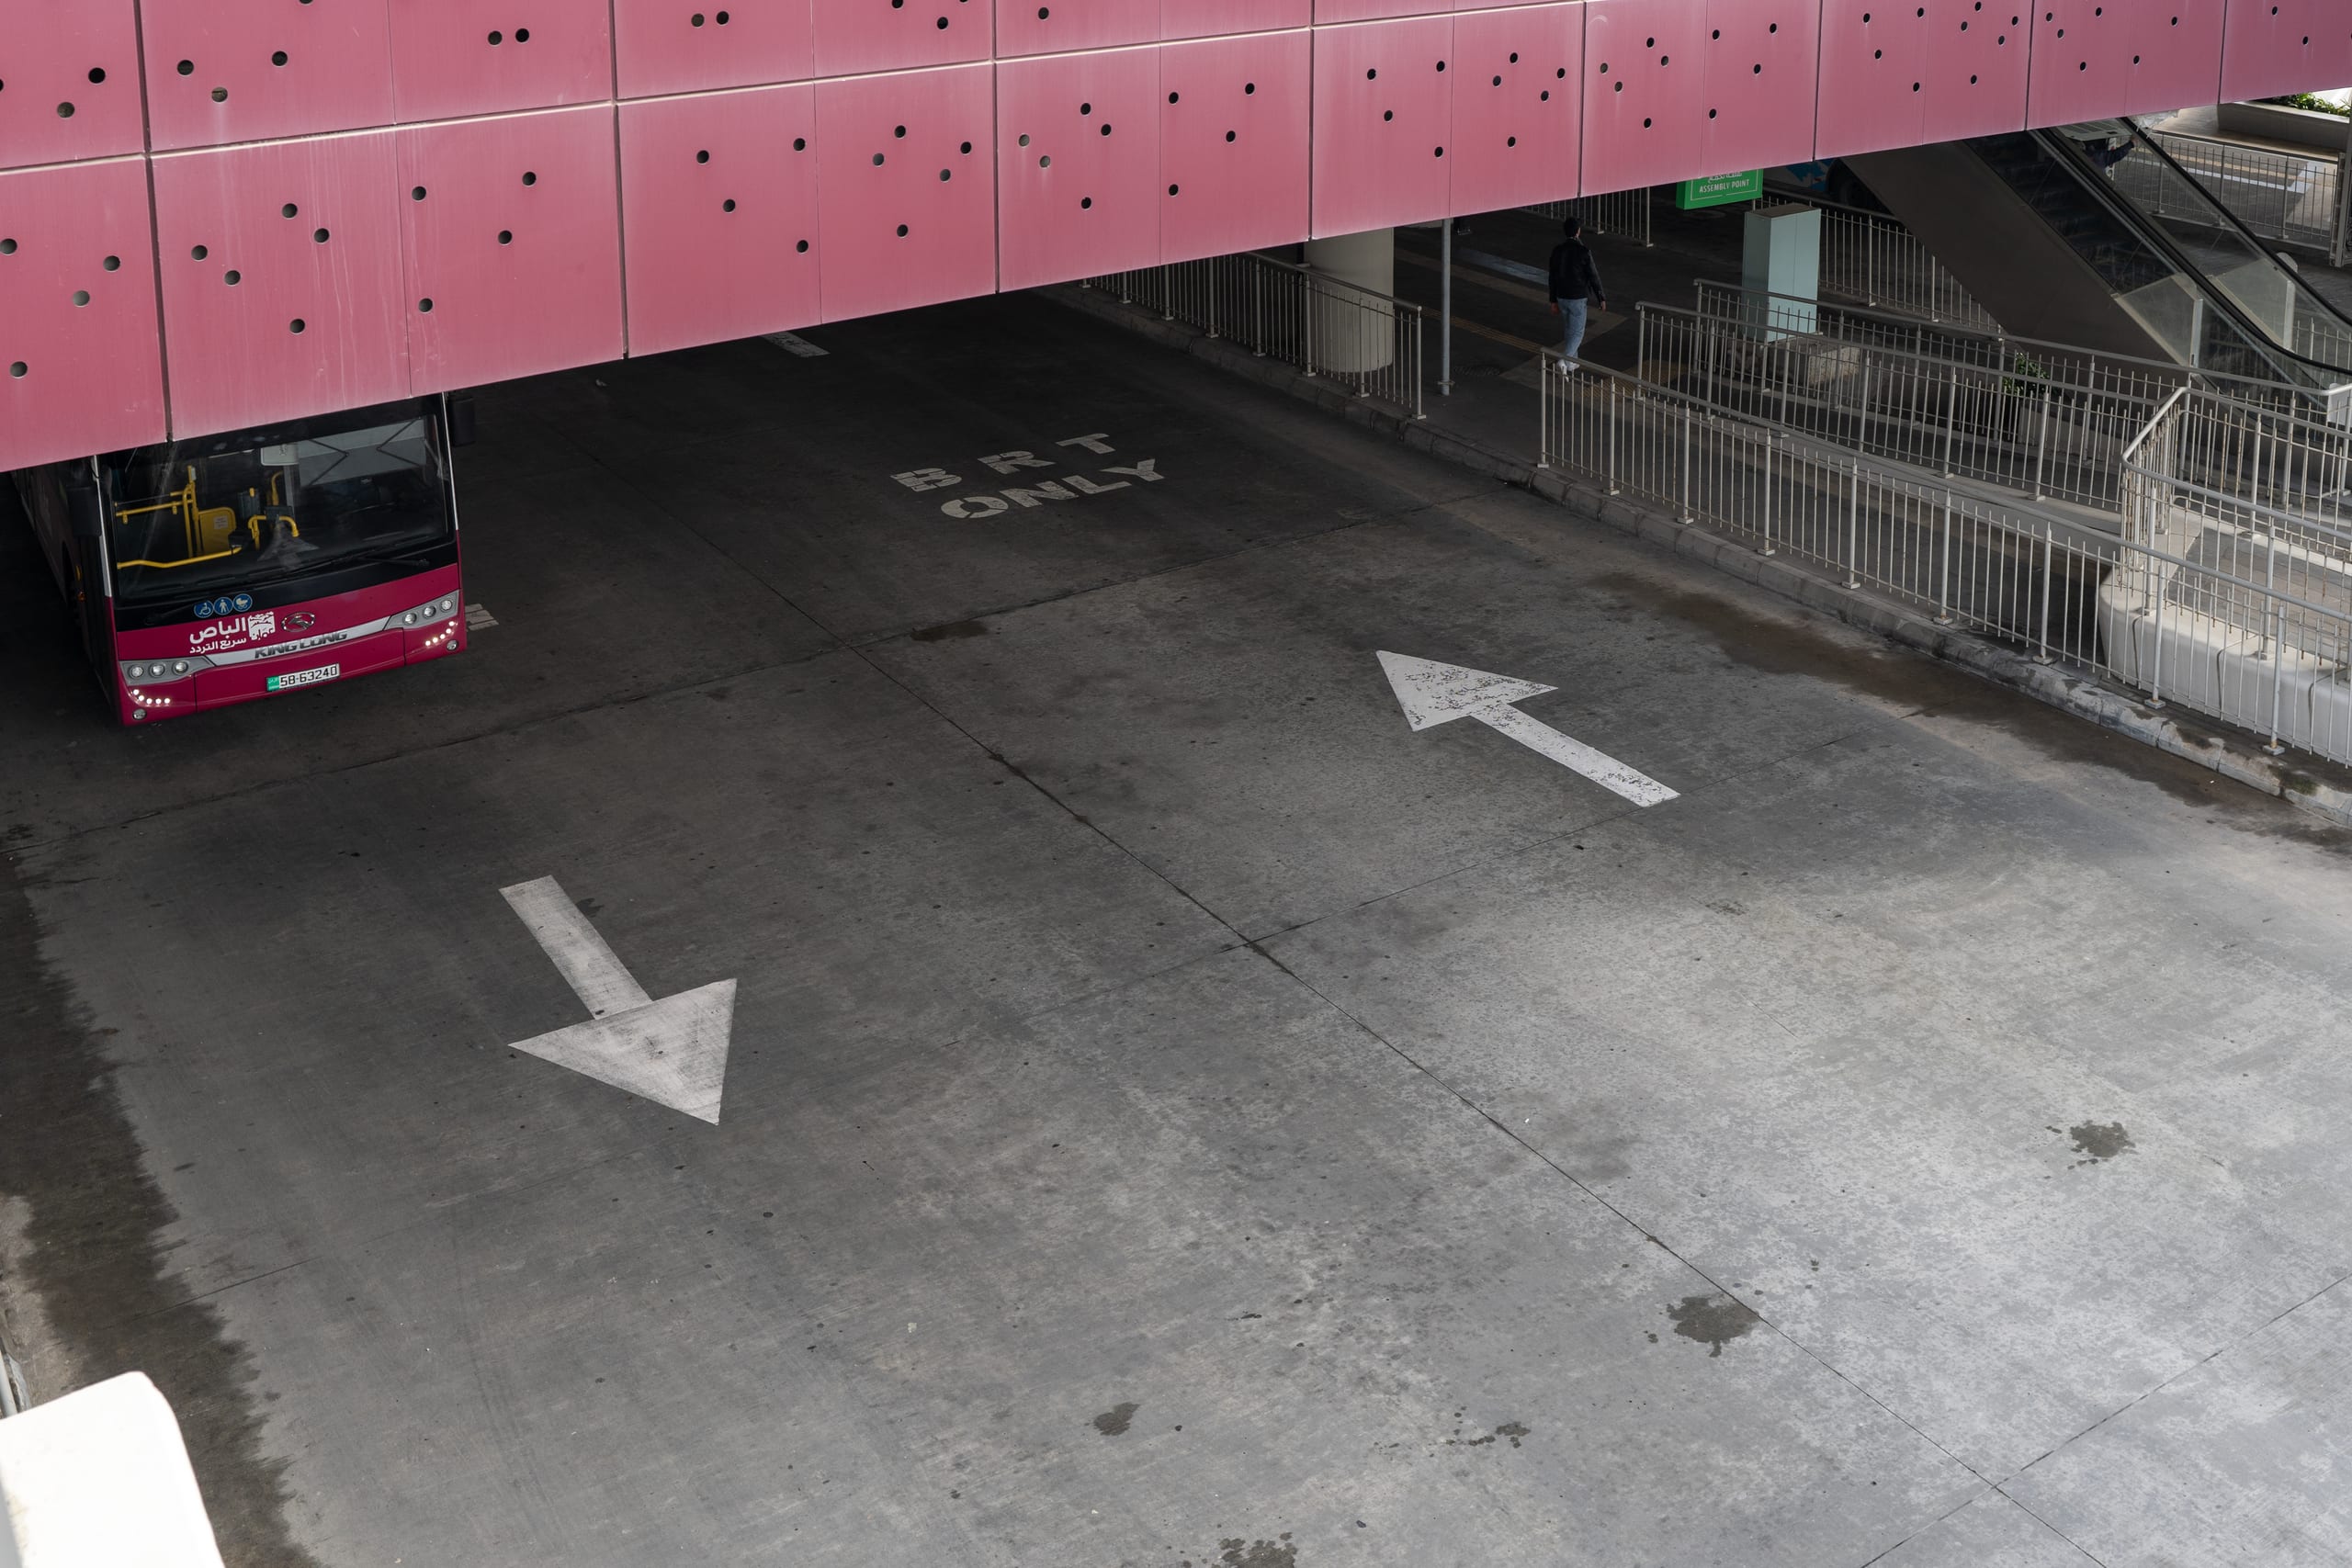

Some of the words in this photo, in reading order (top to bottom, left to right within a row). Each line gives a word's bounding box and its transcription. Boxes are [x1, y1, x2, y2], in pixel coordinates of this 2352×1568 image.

[1699, 182, 1729, 193] ASSEMBLY
[1731, 179, 1749, 188] POINT
[889, 434, 1115, 492] BRT
[940, 458, 1165, 519] ONLY
[189, 616, 246, 644] الباص
[220, 637, 247, 650] سريع
[189, 640, 219, 654] التردد
[254, 645, 297, 659] KING
[300, 631, 347, 649] LONG
